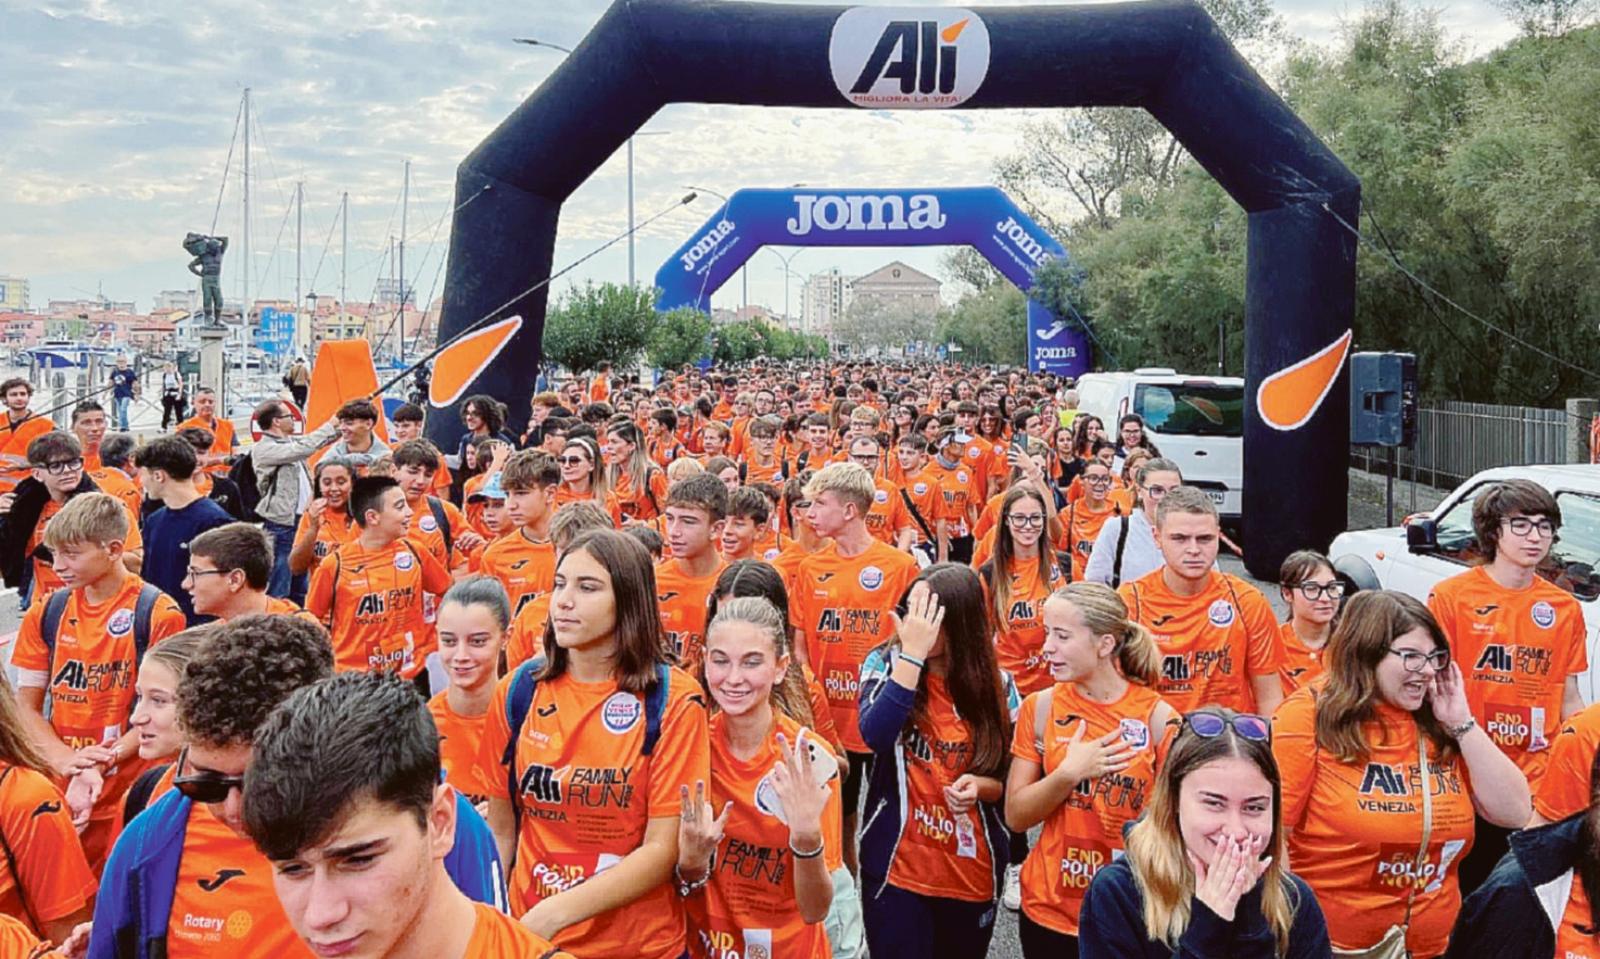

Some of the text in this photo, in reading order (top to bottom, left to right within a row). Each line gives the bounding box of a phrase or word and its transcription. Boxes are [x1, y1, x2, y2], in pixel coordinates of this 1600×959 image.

[854, 95, 909, 103] MIGLIORA
[914, 95, 929, 103] LA
[1516, 646, 1553, 660] FAMILY
[825, 678, 859, 693] POLIO
[1473, 673, 1515, 685] VENEZIA
[571, 766, 634, 785] FAMILY
[567, 784, 627, 809] RUN
[1358, 799, 1417, 813] VENEZIA
[726, 838, 787, 863] FAMILY
[1066, 847, 1104, 865] END
[720, 854, 779, 884] RUN
[1378, 861, 1436, 878] POLIO
[1062, 872, 1093, 888] NO
[184, 913, 224, 931] Rotary
